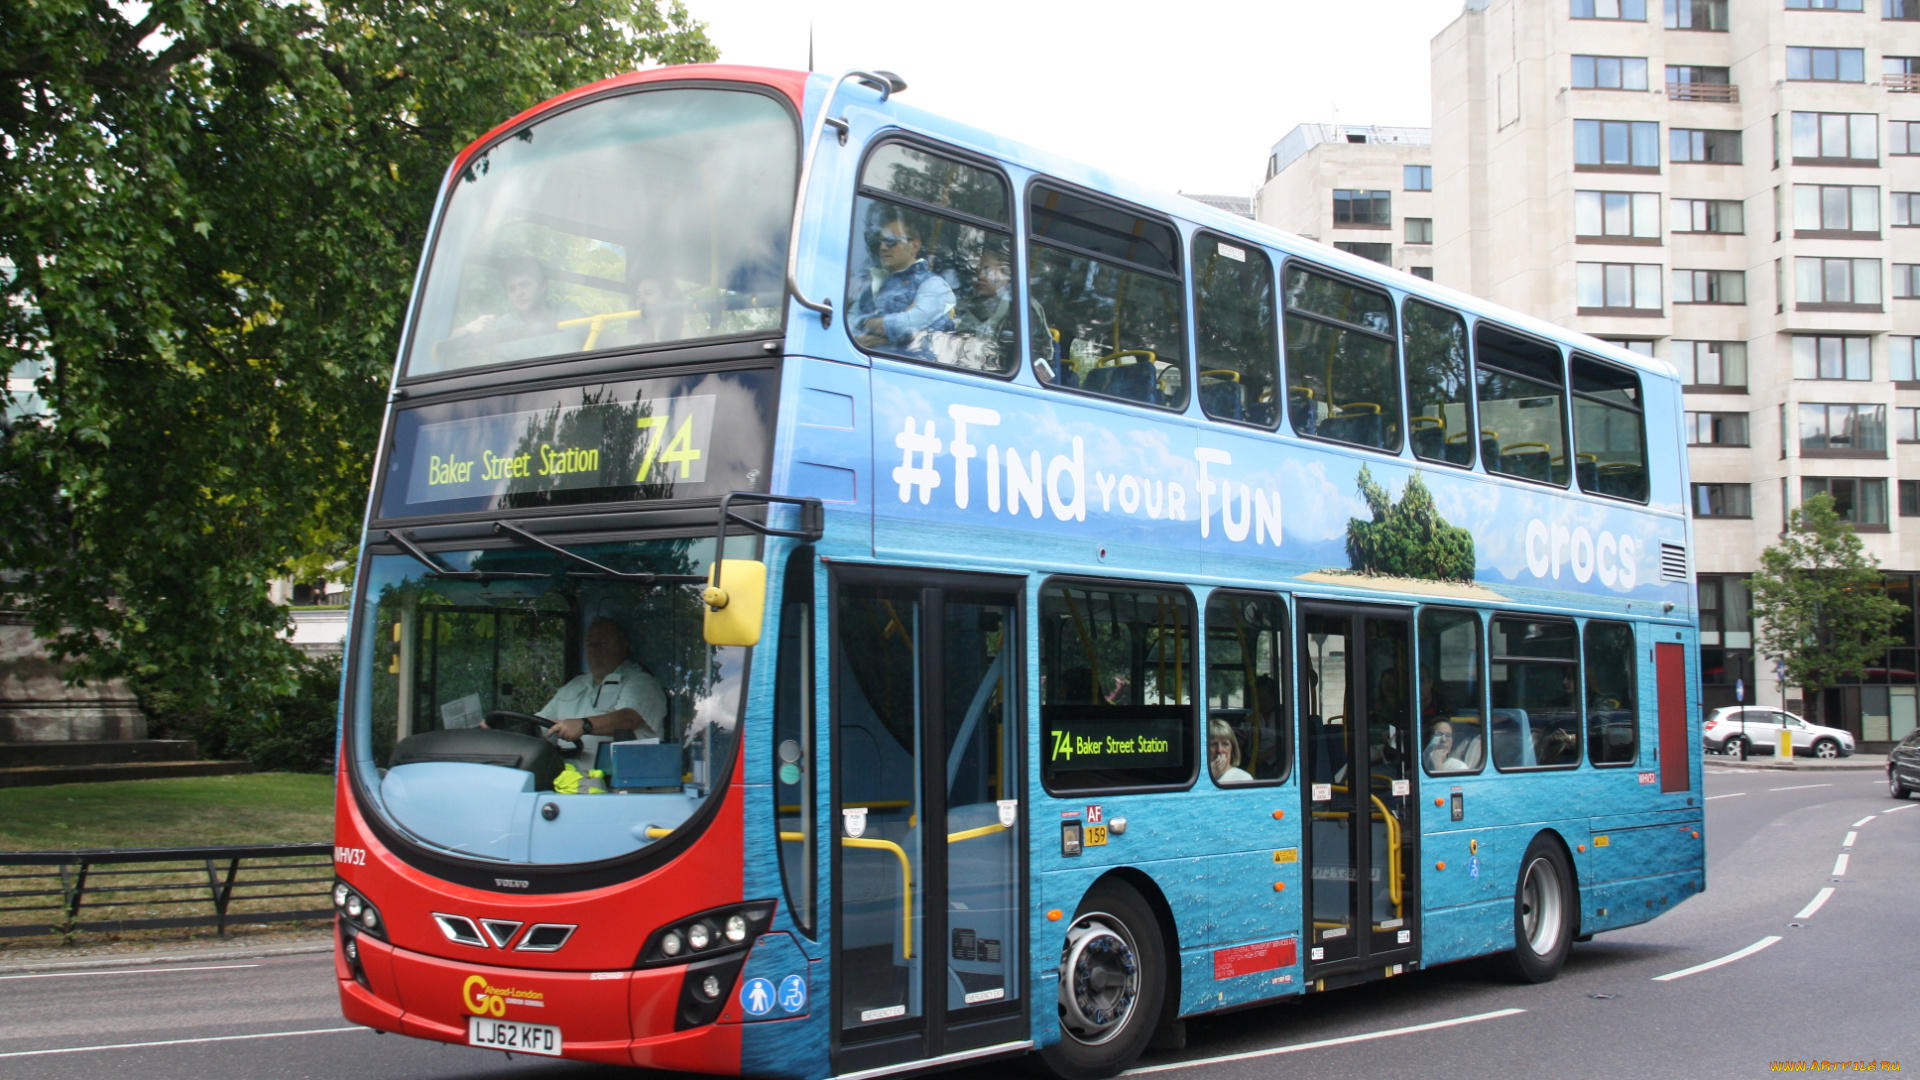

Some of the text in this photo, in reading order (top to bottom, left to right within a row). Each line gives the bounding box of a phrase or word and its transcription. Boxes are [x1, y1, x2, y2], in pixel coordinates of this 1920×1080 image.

[635, 413, 700, 482] 74
[428, 443, 599, 486] Baker Street Station
[1095, 470, 1186, 521] YOUR
[1194, 447, 1282, 547] FUN
[1525, 518, 1637, 589] crocs
[1051, 730, 1168, 761] 74 Baker Street Station
[1087, 805, 1101, 822] AF
[1089, 827, 1106, 844] 159
[494, 878, 530, 888] VOLVO
[463, 975, 506, 1017] Go
[485, 985, 544, 999] Ahead-London
[476, 1021, 553, 1051] LJ62 KFD
